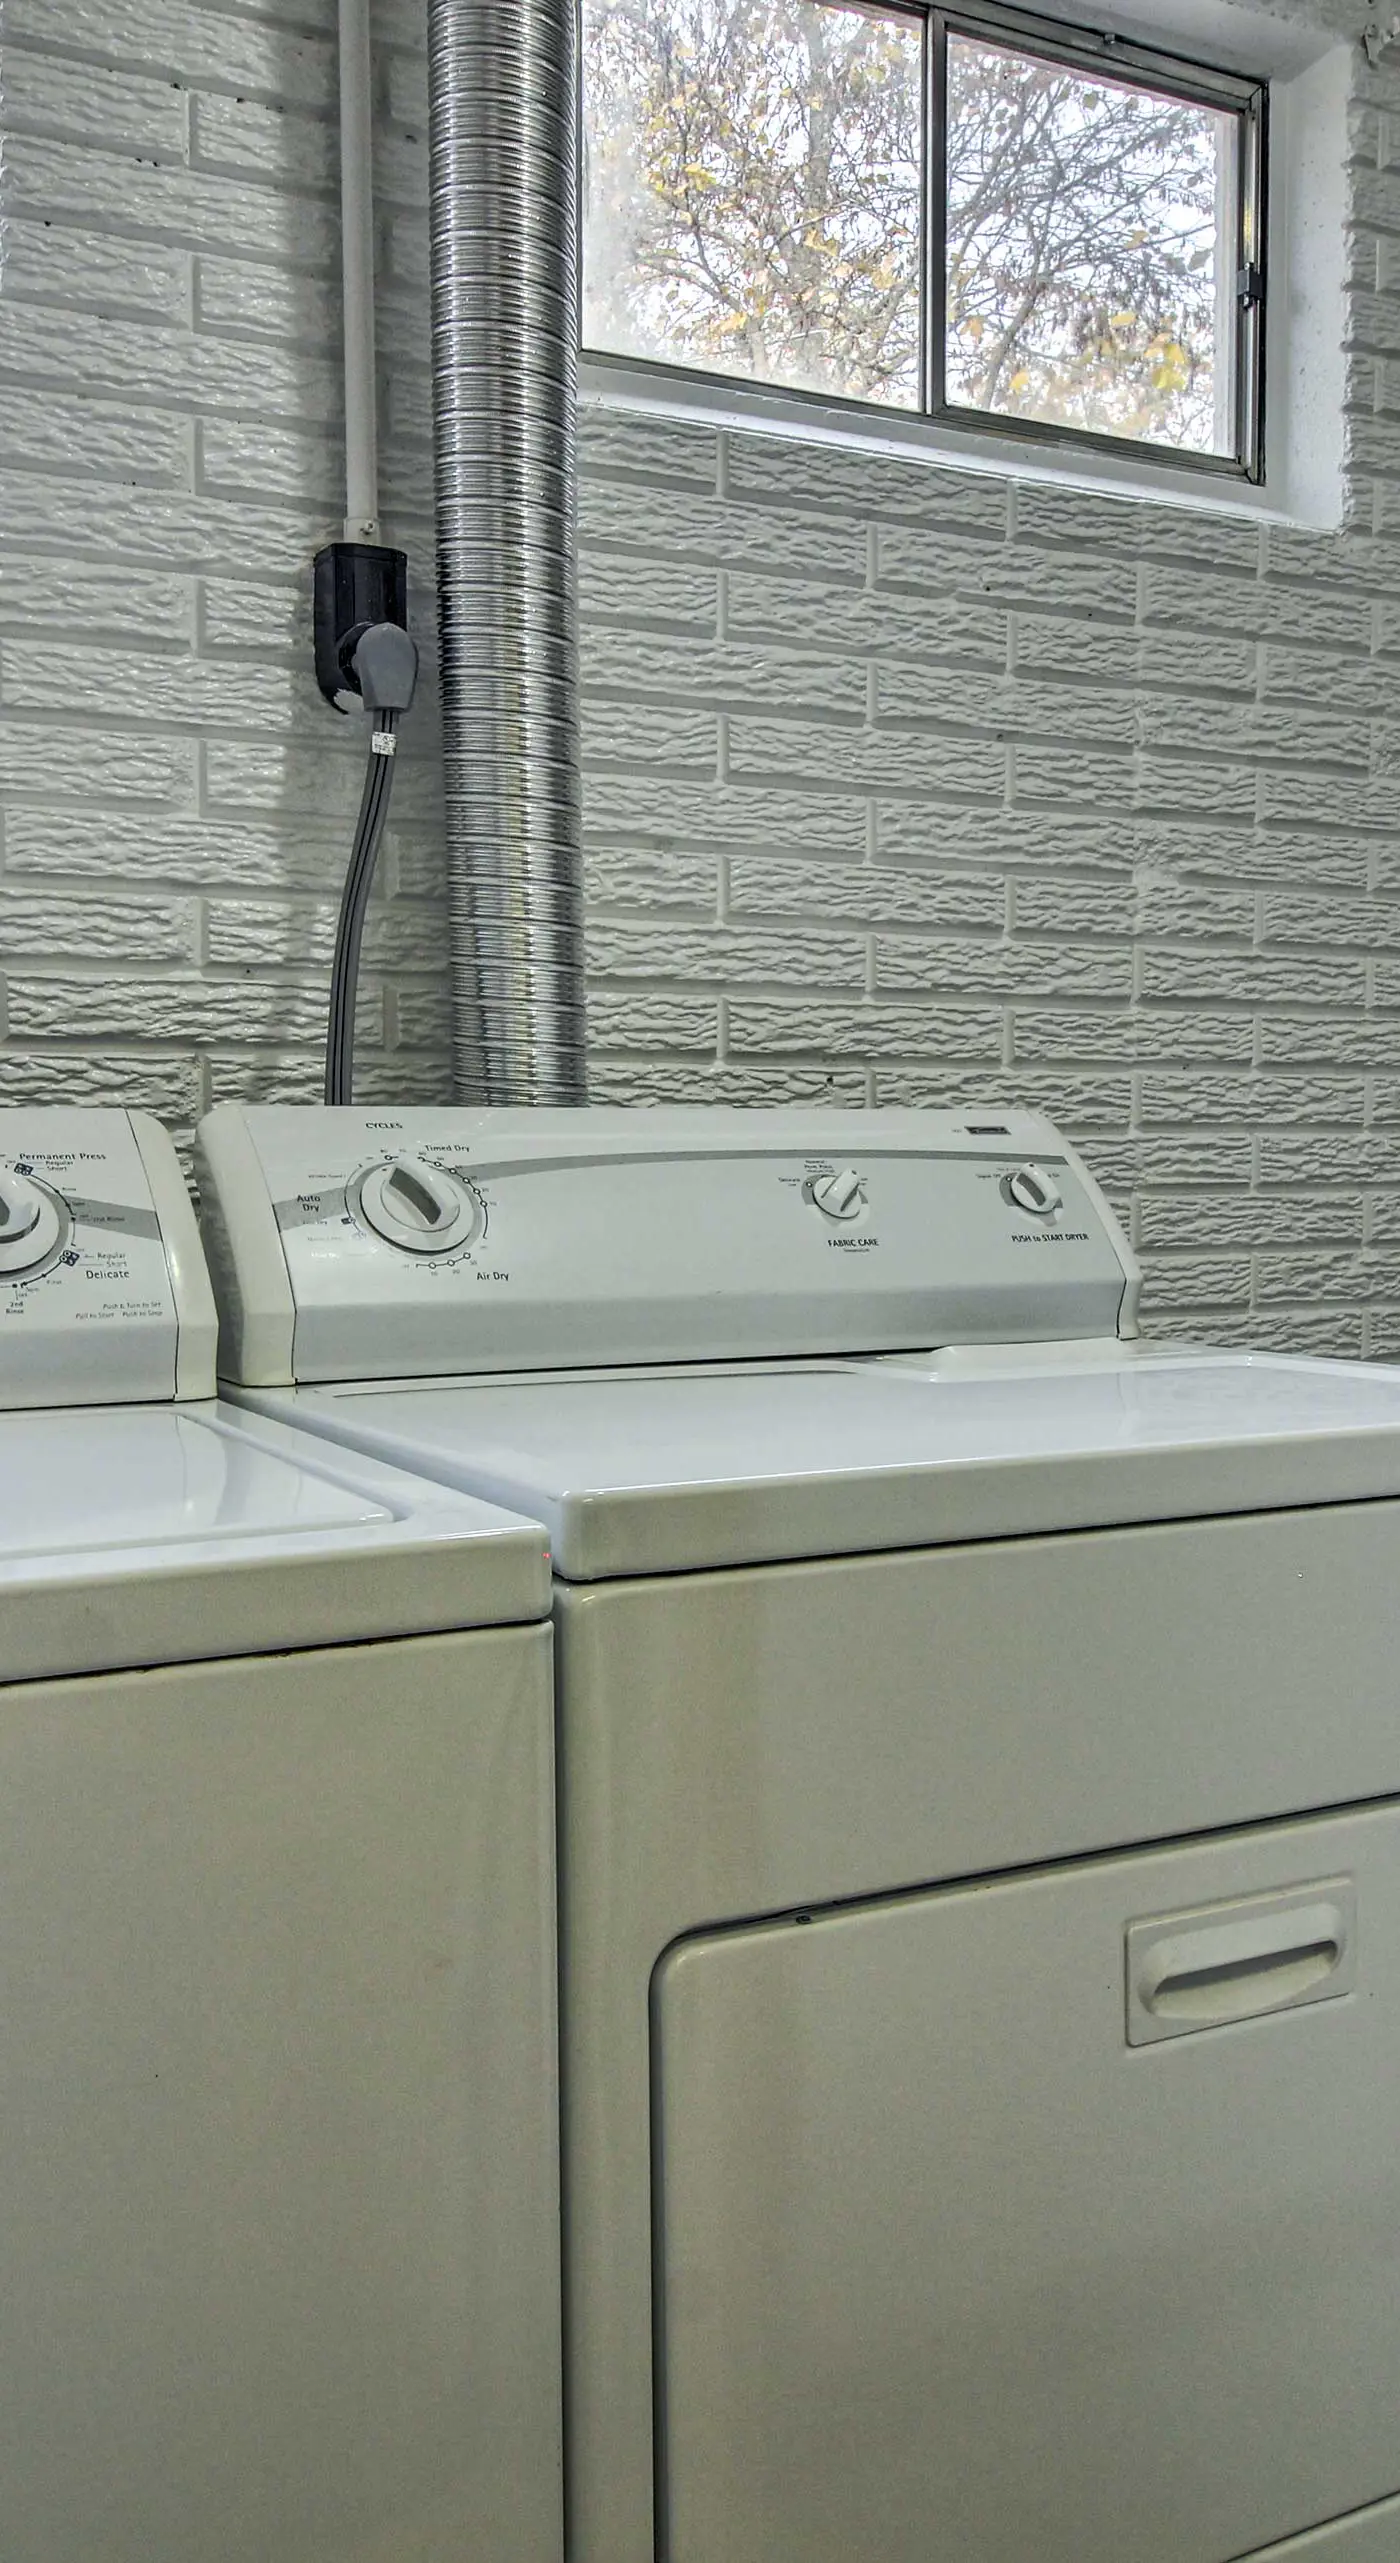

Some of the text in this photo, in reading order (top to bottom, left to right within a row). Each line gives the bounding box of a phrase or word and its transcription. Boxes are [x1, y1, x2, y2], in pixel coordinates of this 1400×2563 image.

[454, 1145, 470, 1153] Dry
[297, 1194, 321, 1203] Auto
[302, 1203, 320, 1213] Dry
[827, 1238, 880, 1247] FABRIC CARE
[1011, 1235, 1032, 1243] PUSH
[1042, 1234, 1064, 1242] START
[1065, 1233, 1090, 1241] DRYER
[86, 1269, 130, 1280] Delicate
[476, 1271, 509, 1281] Air Dry
